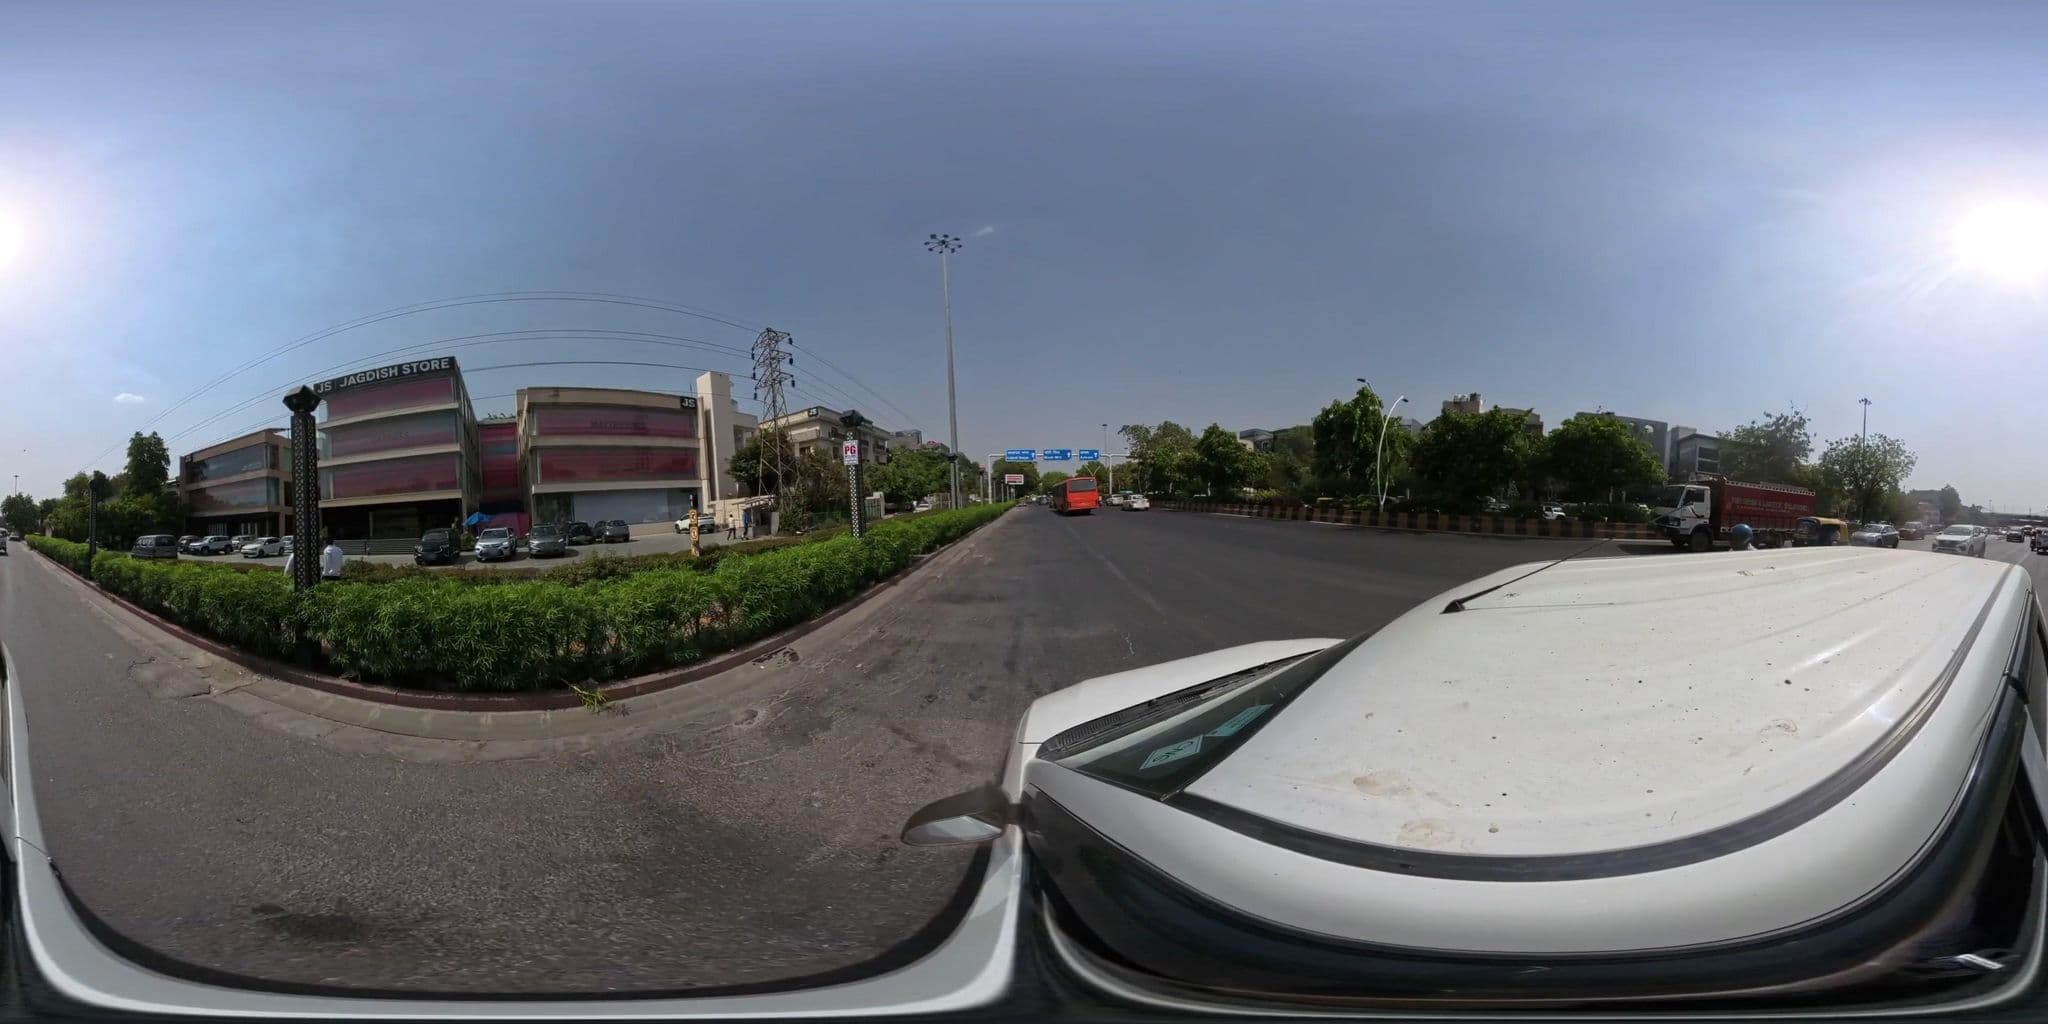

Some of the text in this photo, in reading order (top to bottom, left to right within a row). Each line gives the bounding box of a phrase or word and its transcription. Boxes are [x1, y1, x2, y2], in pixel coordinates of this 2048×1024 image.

[317, 358, 450, 393] JS JAGDISH STORE
[682, 398, 695, 407] JS
[845, 445, 856, 455] PG
